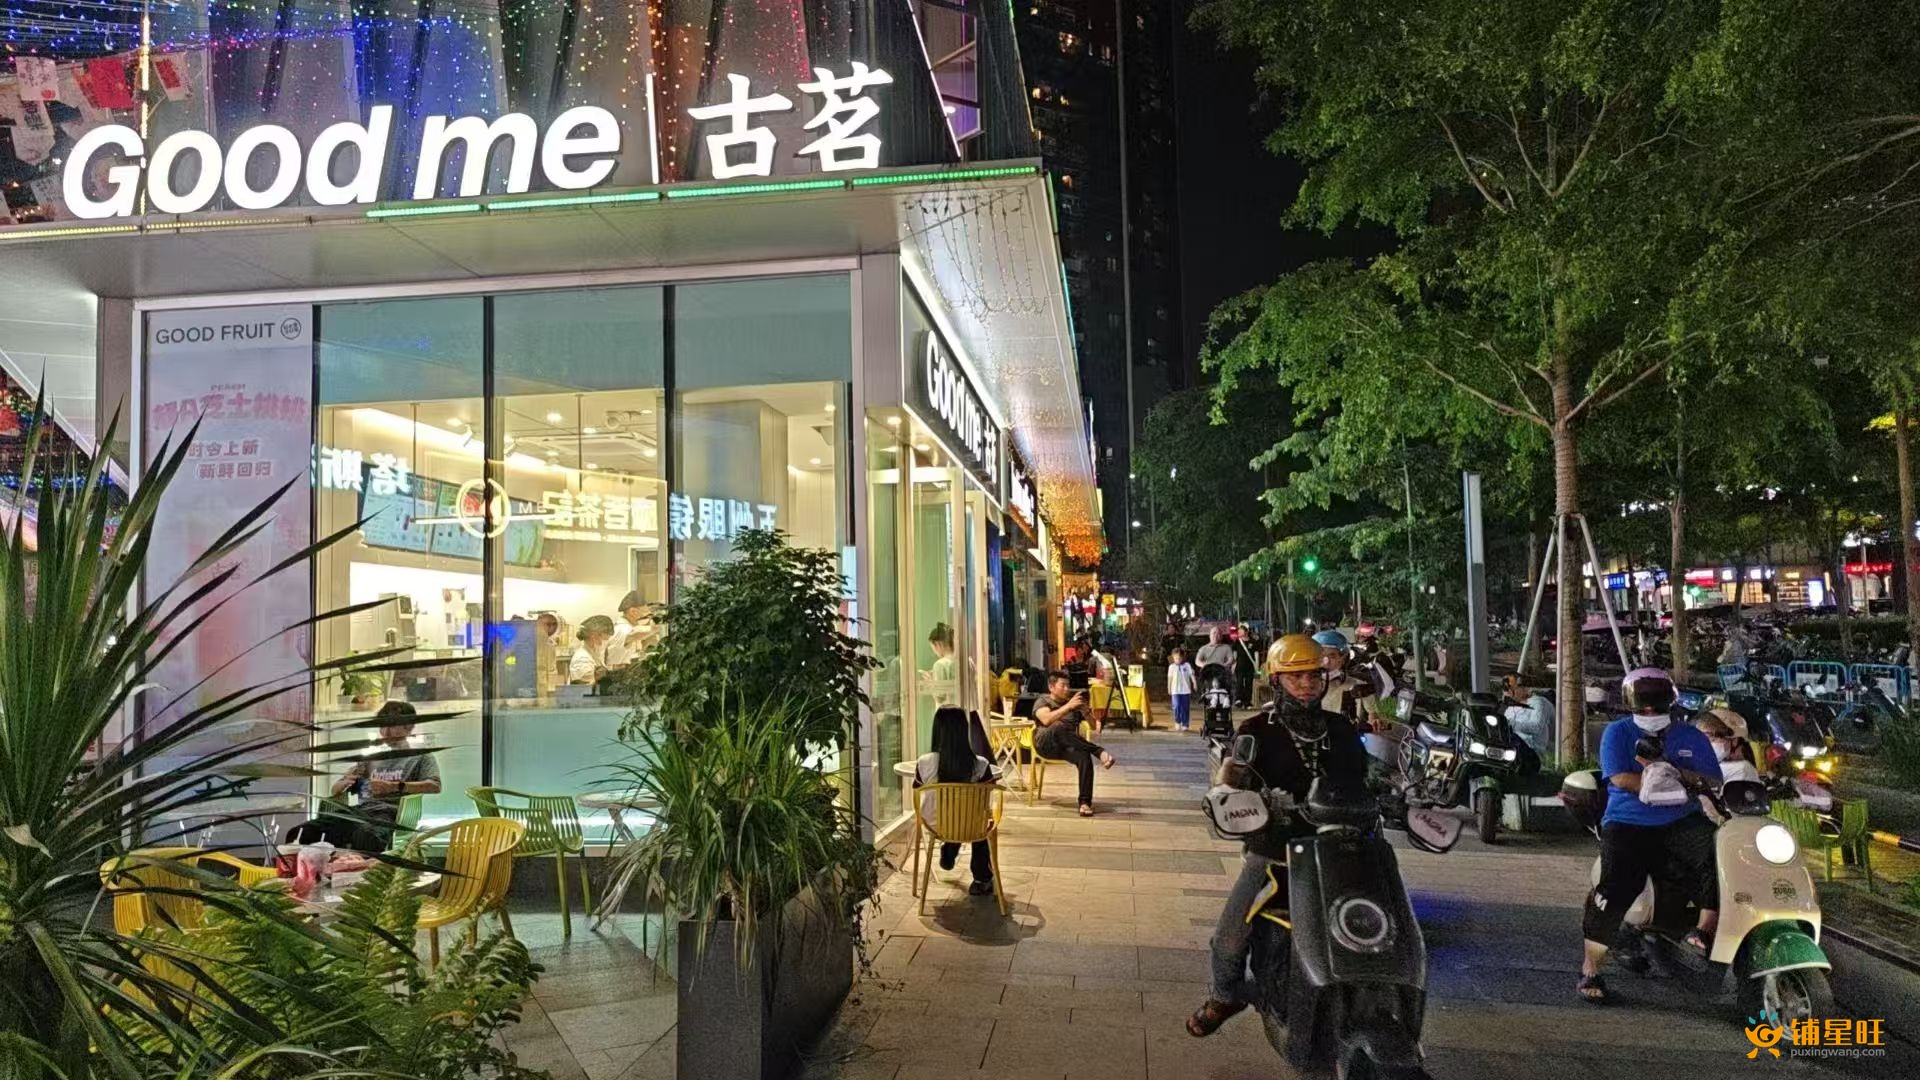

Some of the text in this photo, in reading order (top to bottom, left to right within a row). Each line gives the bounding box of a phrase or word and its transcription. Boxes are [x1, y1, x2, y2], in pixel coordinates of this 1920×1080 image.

[62, 104, 621, 220] Good me
[687, 60, 894, 180] 古茗
[155, 326, 215, 345] GOOD
[220, 322, 275, 341] FRUIT
[926, 330, 982, 462] Good me
[199, 461, 272, 479] 新鲜回归
